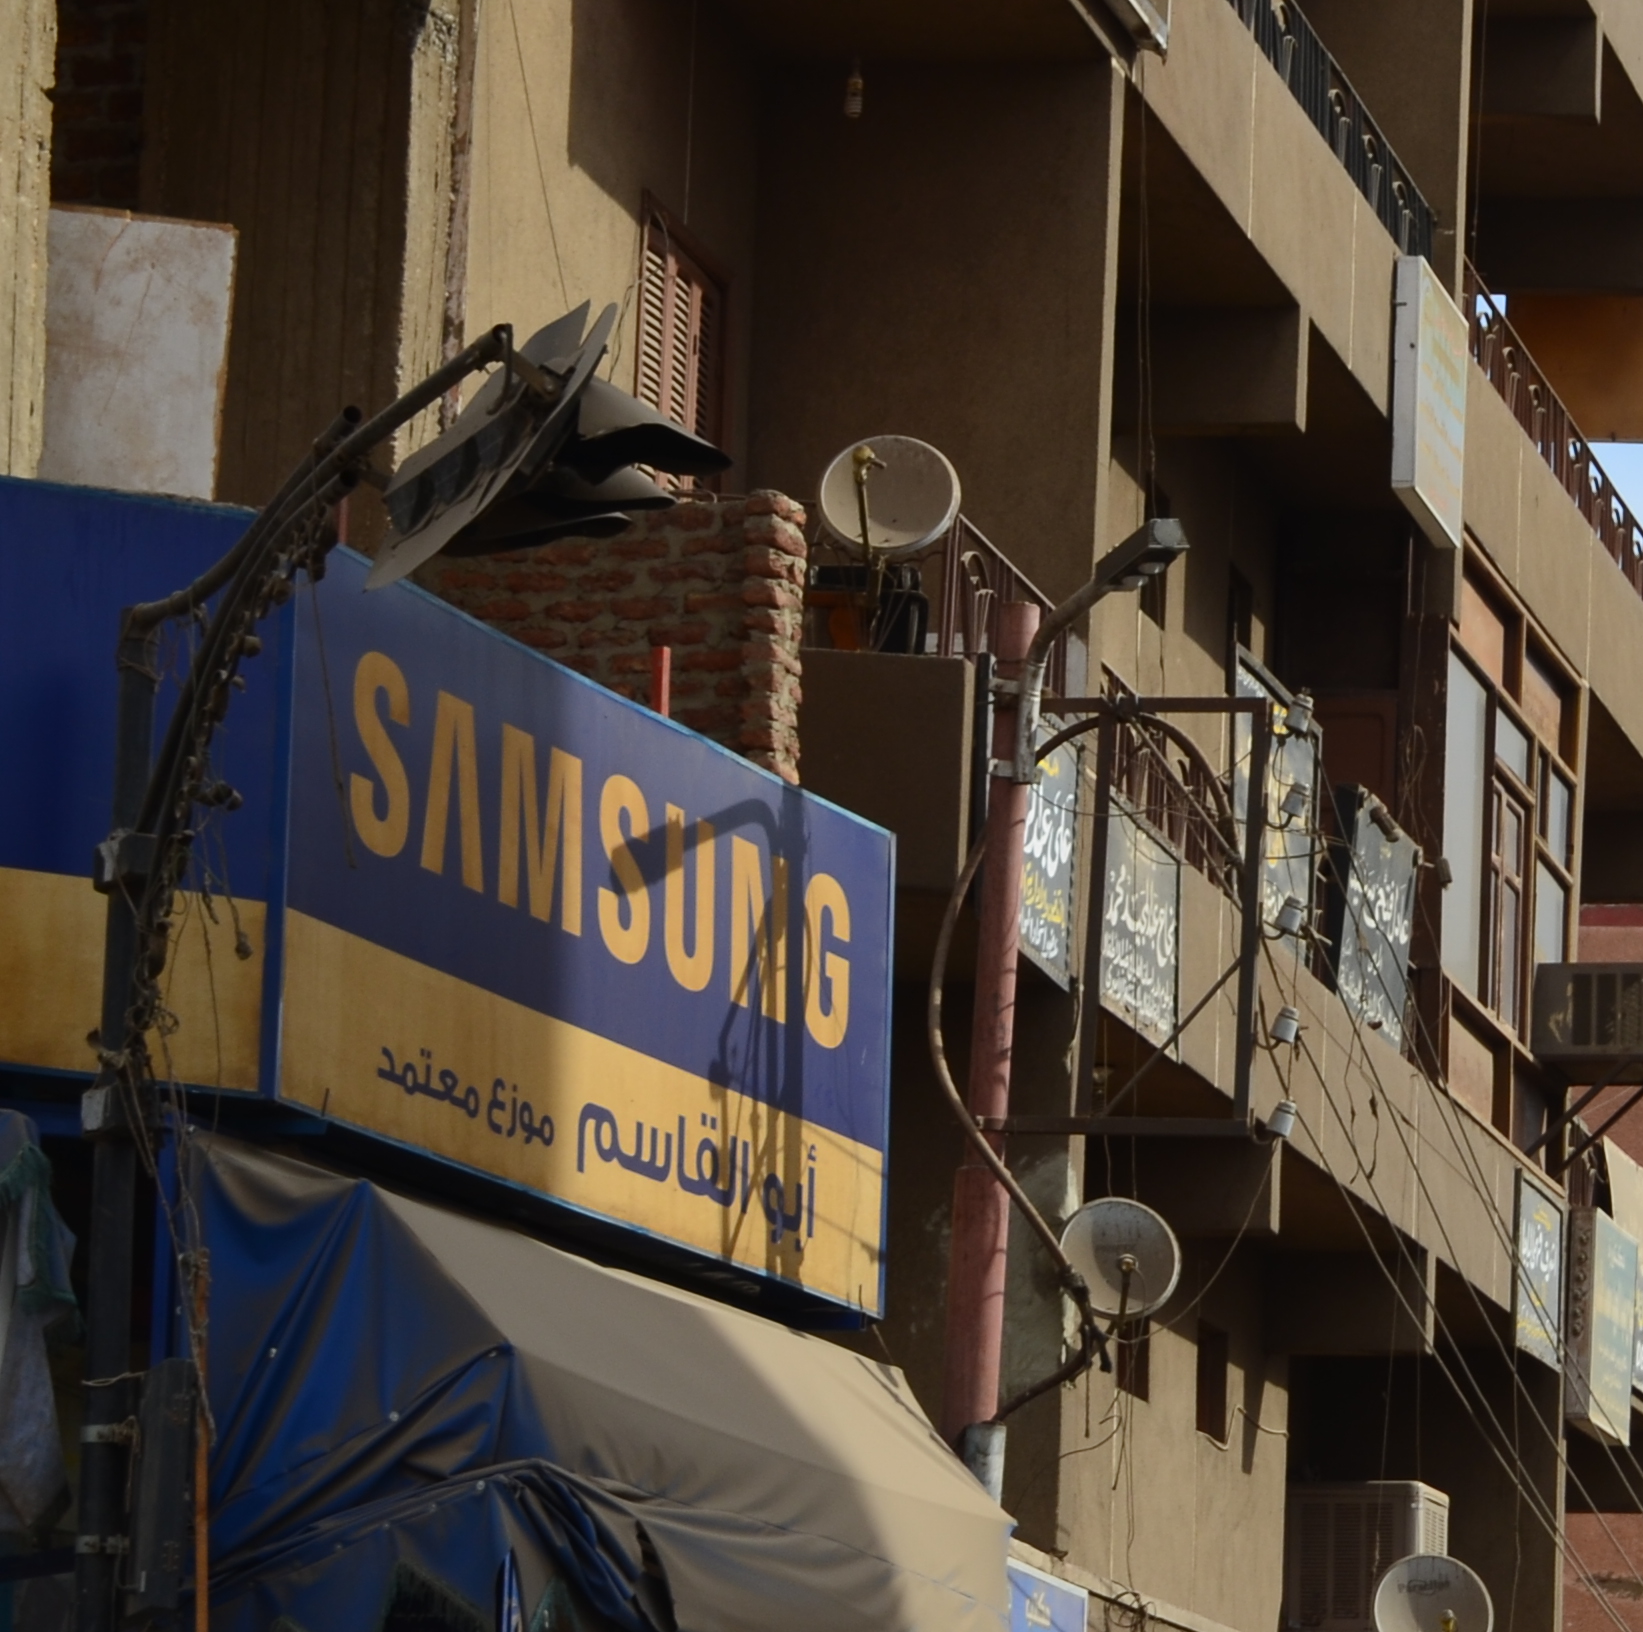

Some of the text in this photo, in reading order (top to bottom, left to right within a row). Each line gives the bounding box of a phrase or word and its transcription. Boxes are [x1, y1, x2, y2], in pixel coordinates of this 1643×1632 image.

[349, 651, 851, 1049] SAMSUNG
[378, 1047, 555, 1147] موزع معتمد
